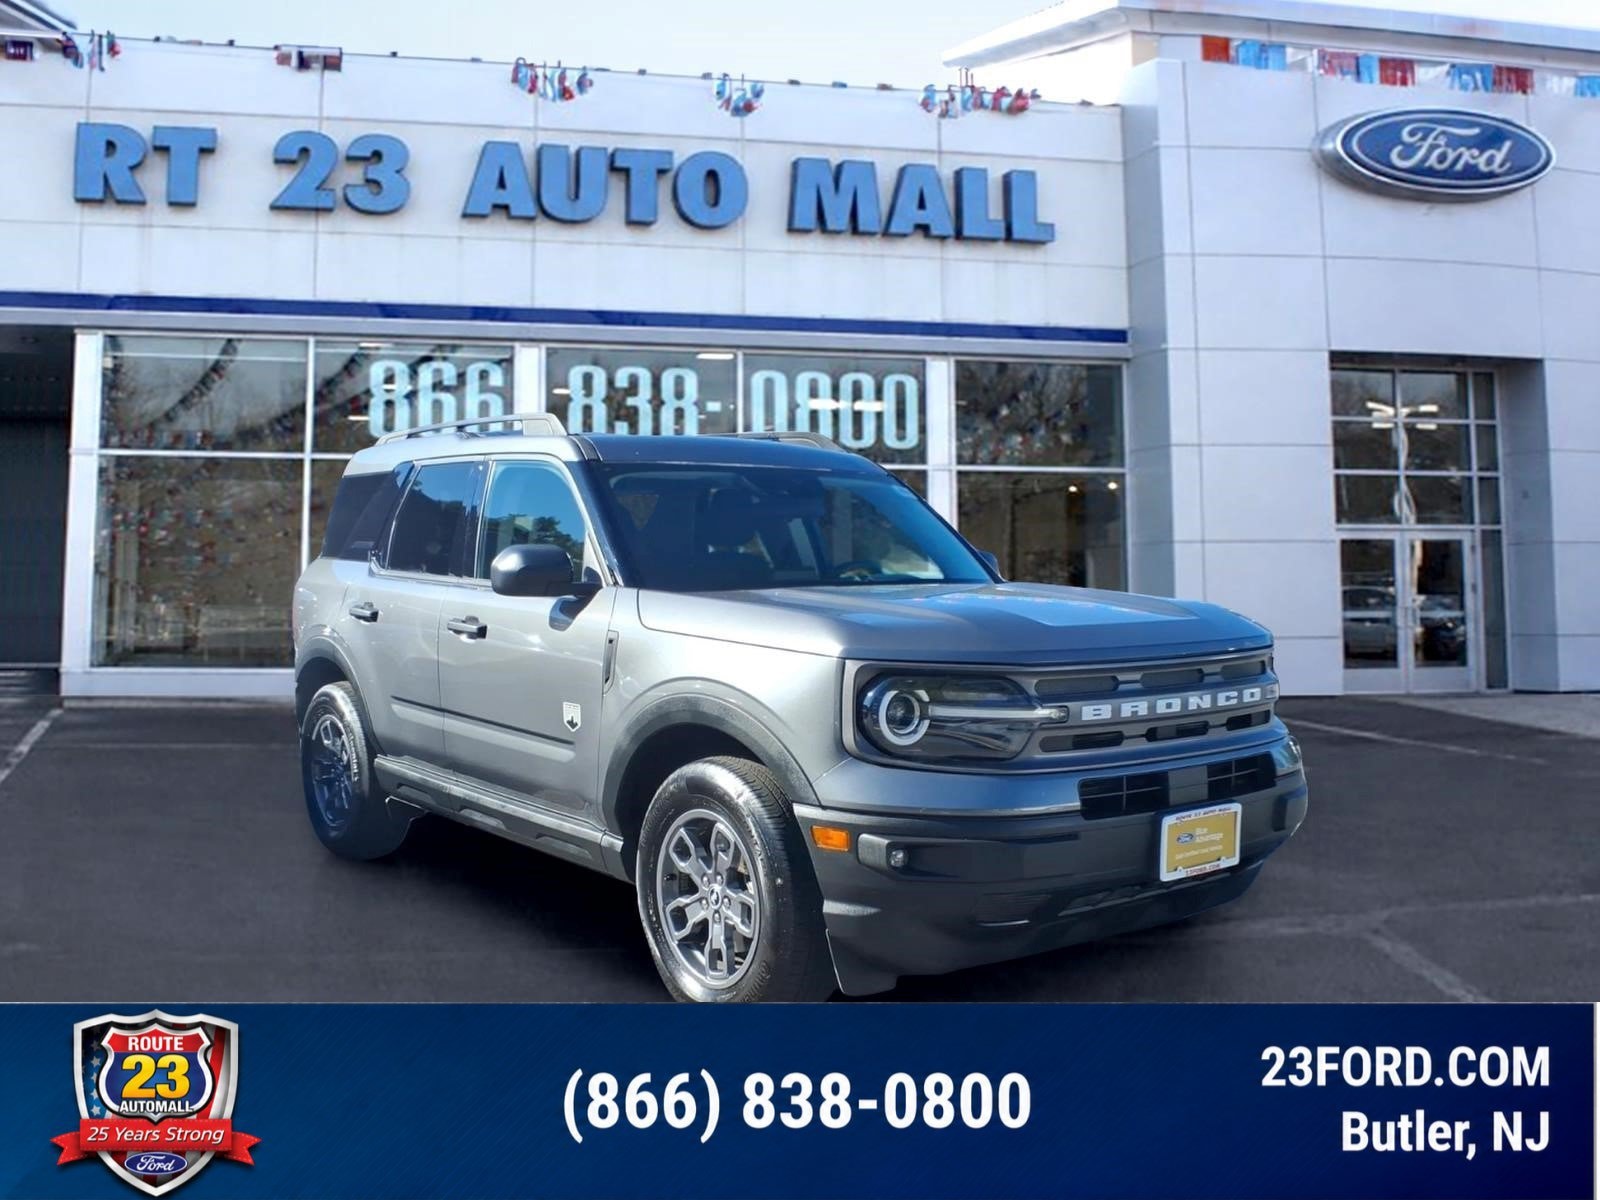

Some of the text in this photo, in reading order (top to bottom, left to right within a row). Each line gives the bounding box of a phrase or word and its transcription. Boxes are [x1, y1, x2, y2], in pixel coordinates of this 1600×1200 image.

[1390, 122, 1513, 173] Ford
[74, 122, 1055, 243] RT 23 AUTO MALL
[369, 359, 504, 438] 866
[1081, 687, 1262, 721] BRONCO
